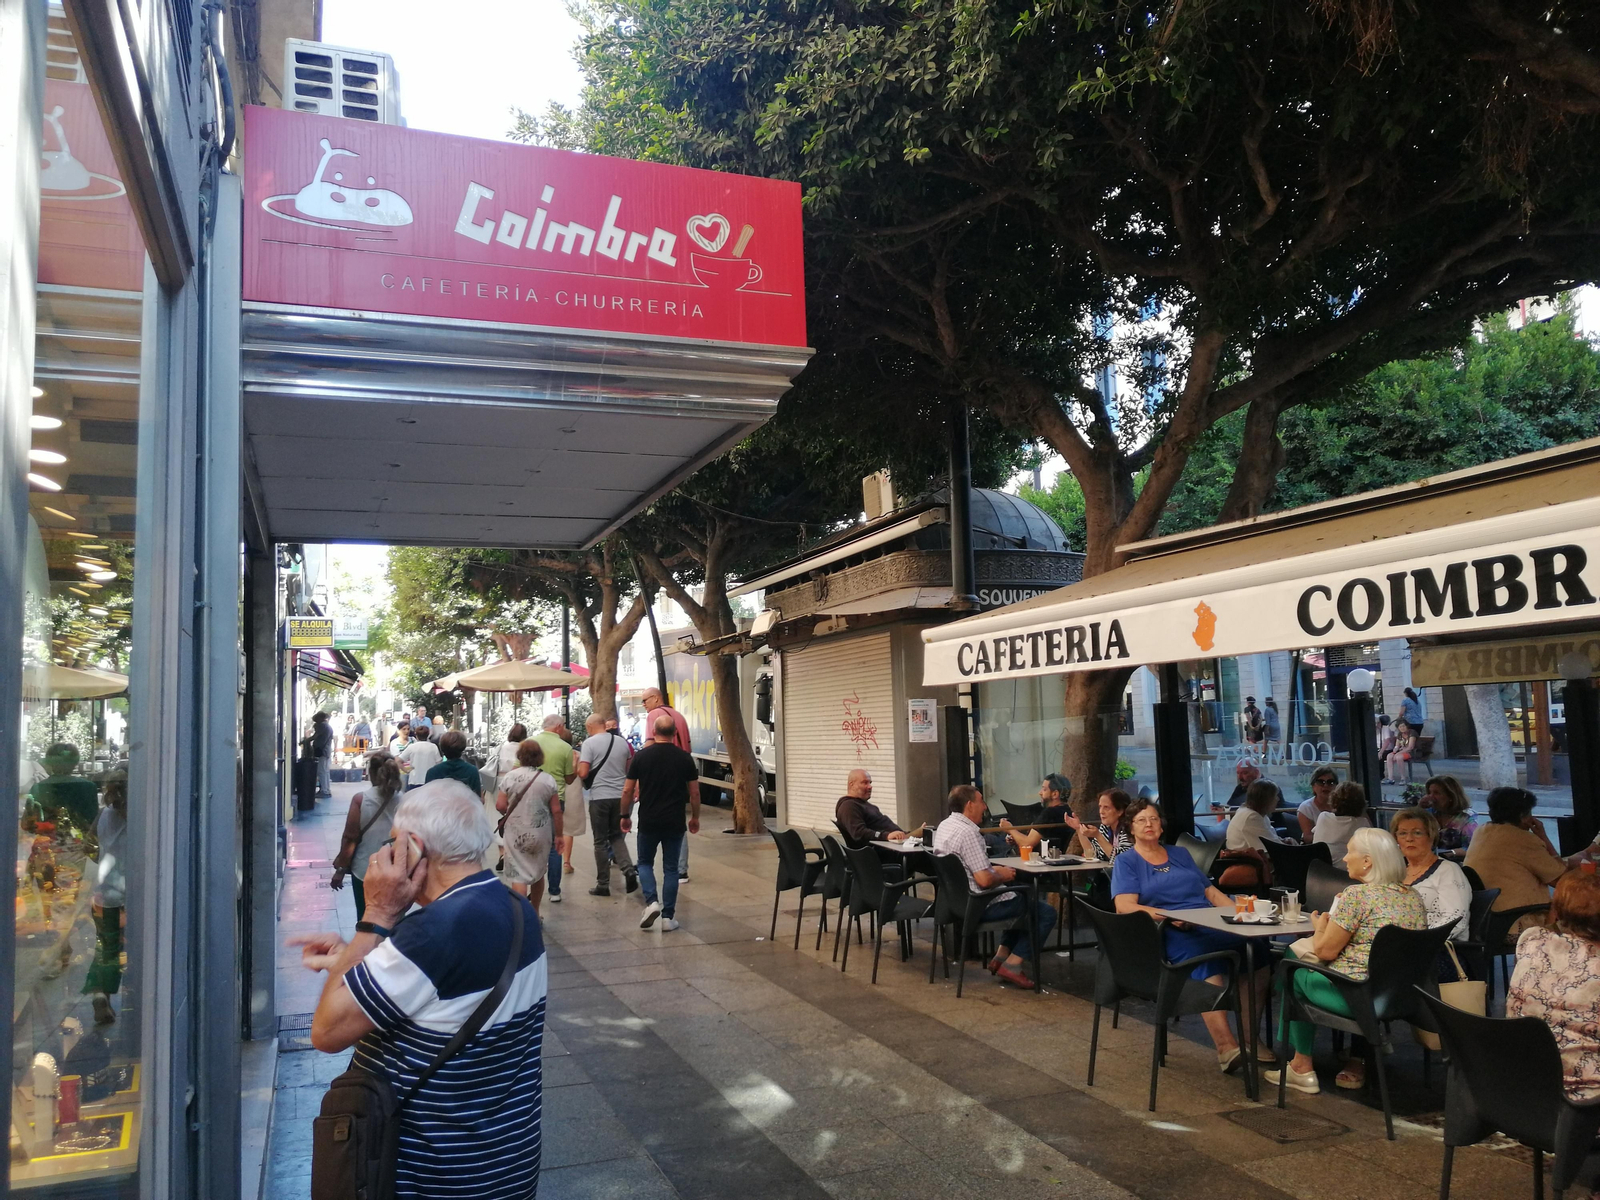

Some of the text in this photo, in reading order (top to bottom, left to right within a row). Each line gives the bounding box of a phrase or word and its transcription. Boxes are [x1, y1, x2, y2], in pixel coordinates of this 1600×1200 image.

[454, 180, 677, 267] Coimbra
[290, 620, 300, 628] SE
[301, 620, 332, 628] ALQUILA
[957, 544, 1600, 677] CAFETERIA COIMBR
[667, 662, 722, 731] akr
